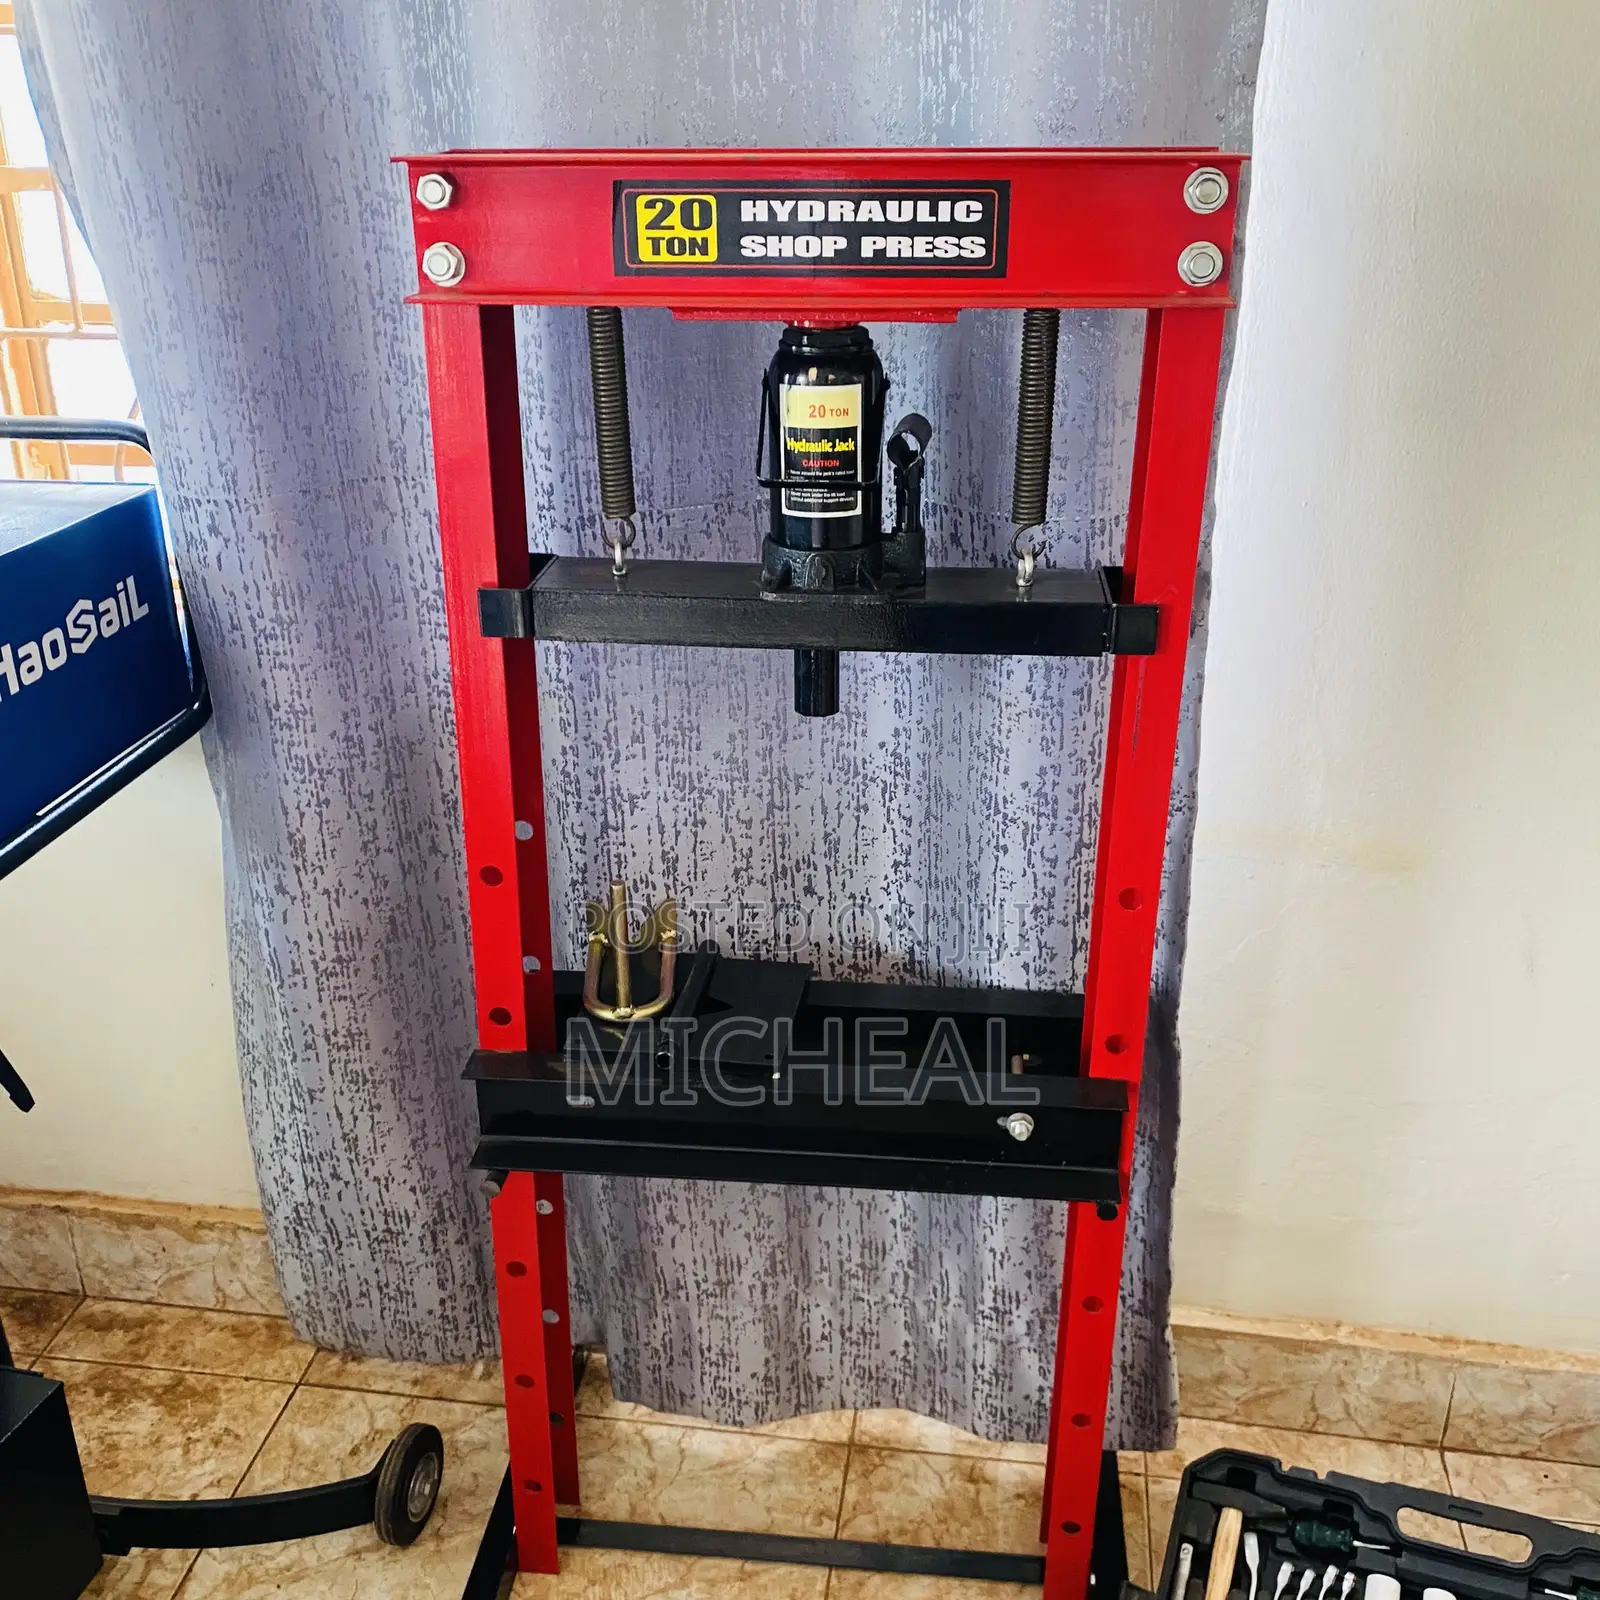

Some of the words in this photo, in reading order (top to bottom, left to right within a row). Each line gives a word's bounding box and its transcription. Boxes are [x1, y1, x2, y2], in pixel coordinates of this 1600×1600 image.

[644, 198, 712, 231] 20
[740, 200, 984, 223] HYDRAULIC
[646, 236, 710, 256] TON
[740, 235, 848, 258] SHOP
[861, 236, 987, 259] PRESS
[808, 404, 826, 418] 20
[829, 408, 849, 417] TON
[786, 437, 833, 453] Hydraulic
[834, 437, 855, 452] Jack
[802, 459, 840, 467] CAUTION
